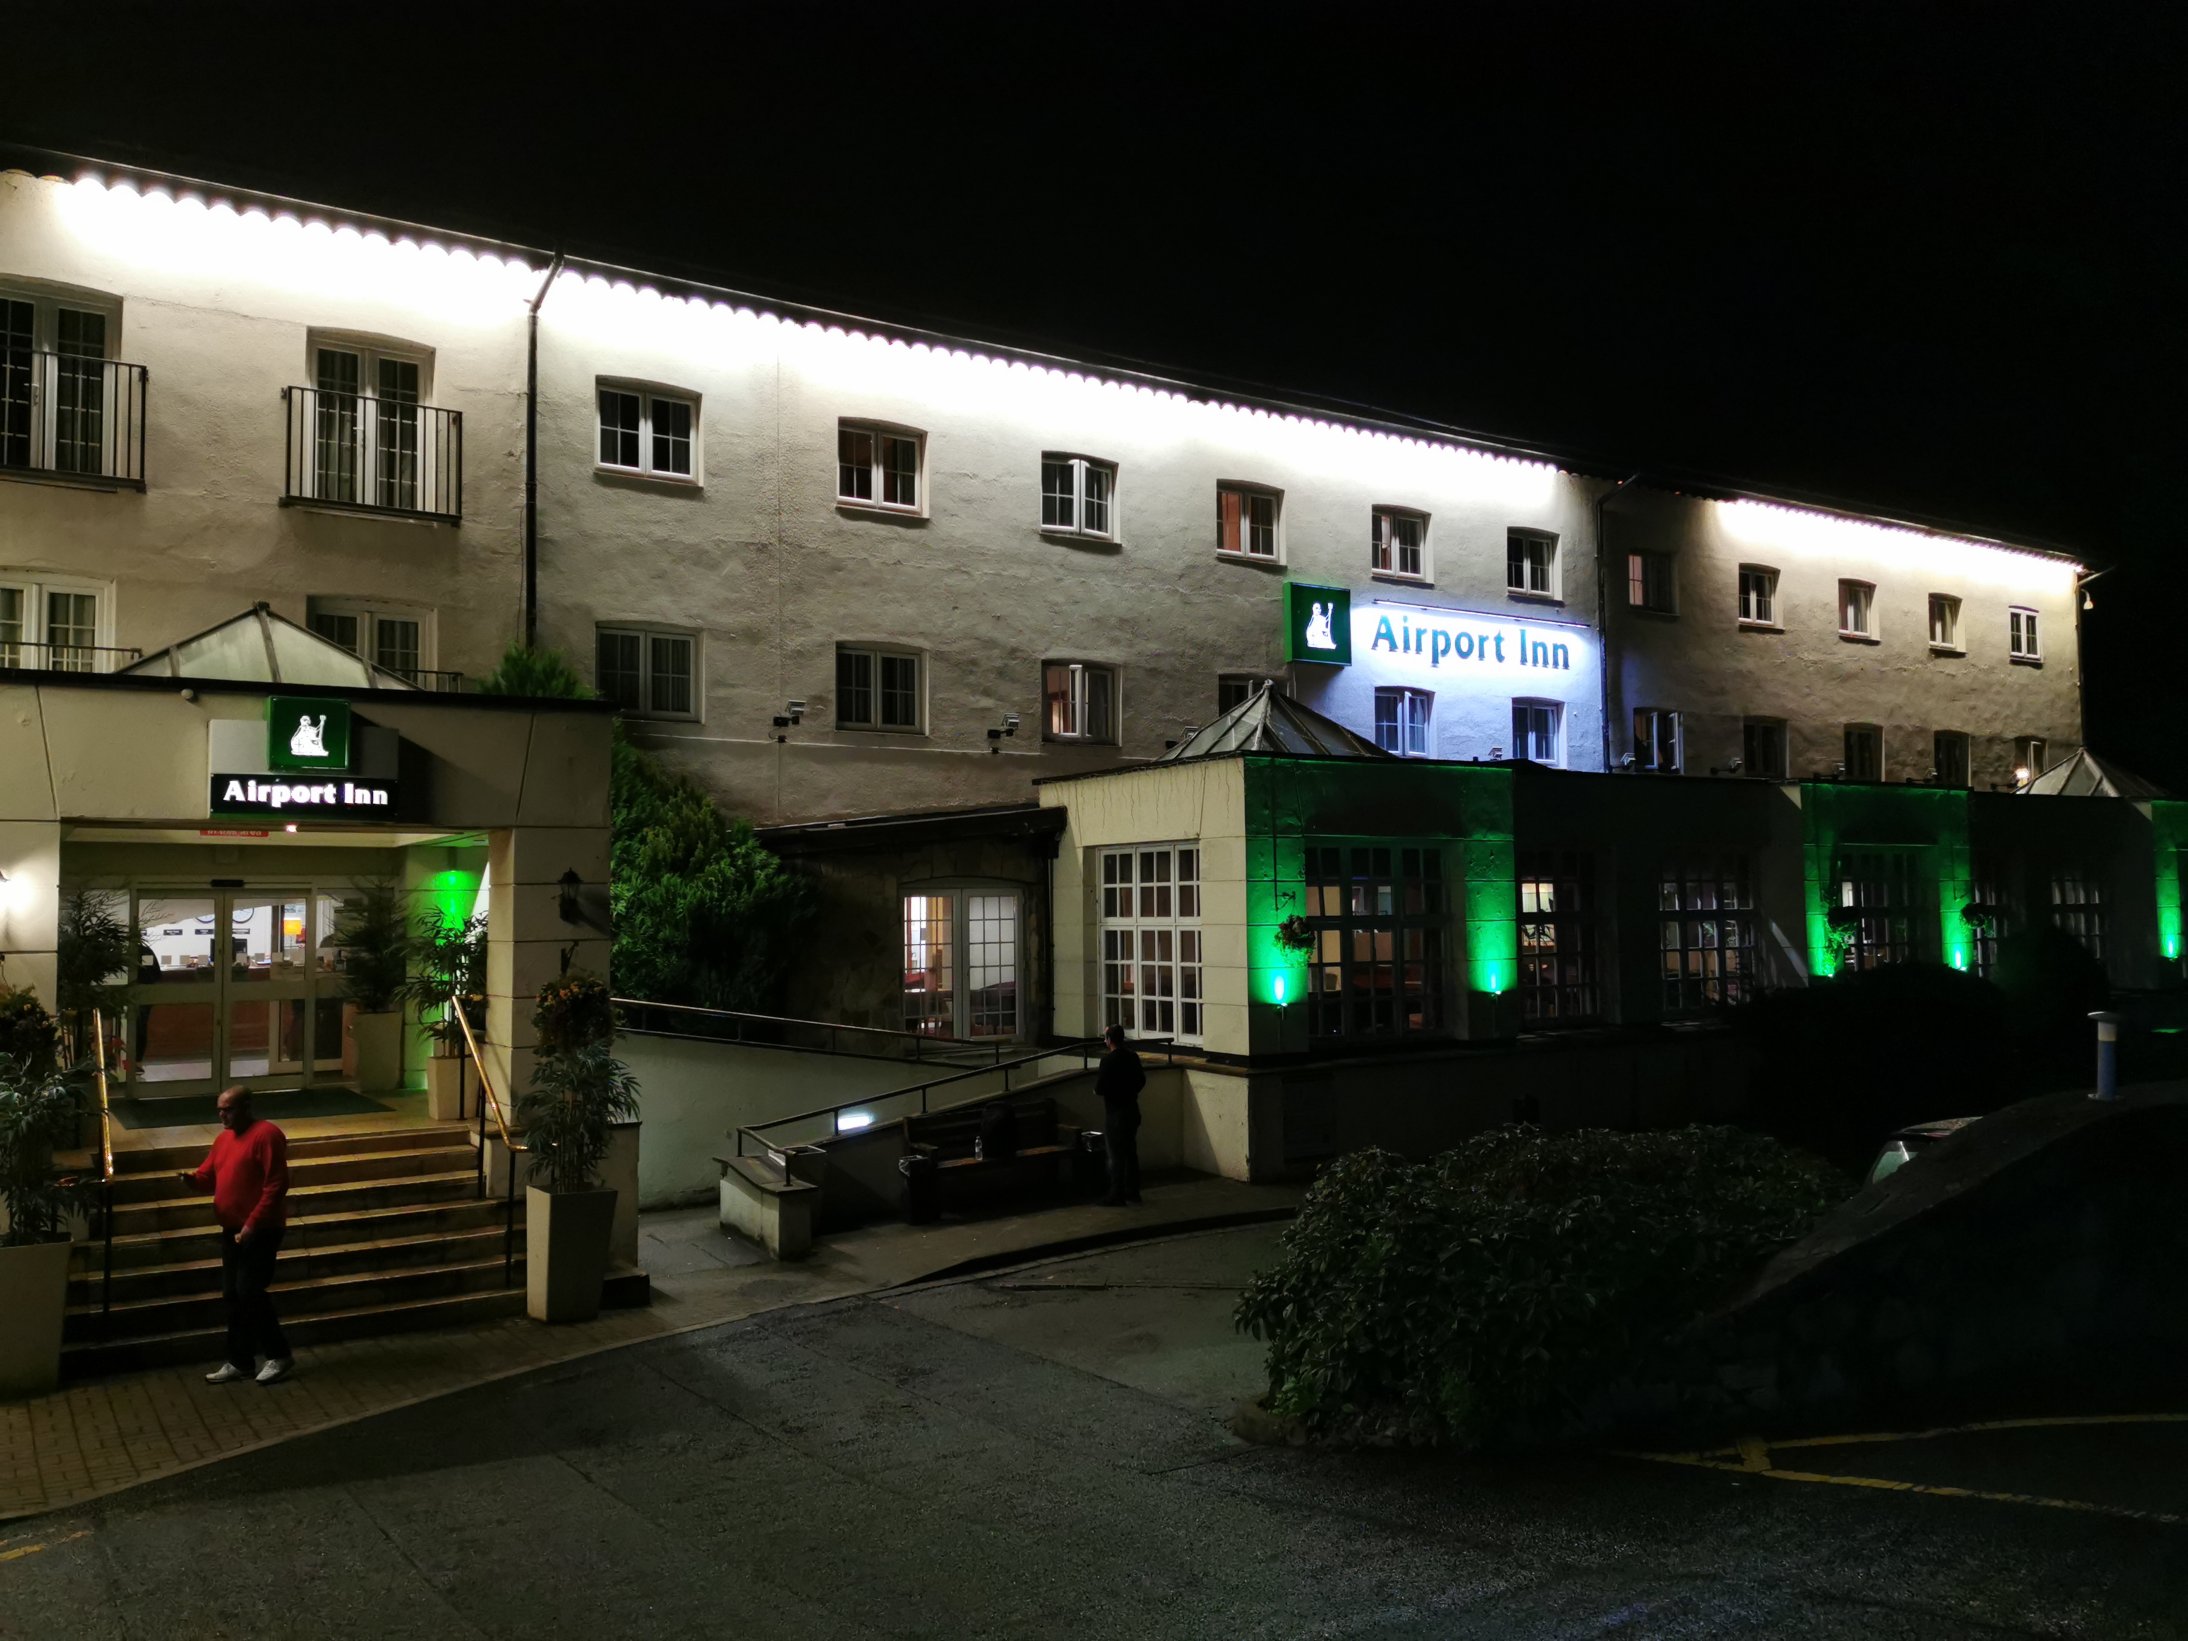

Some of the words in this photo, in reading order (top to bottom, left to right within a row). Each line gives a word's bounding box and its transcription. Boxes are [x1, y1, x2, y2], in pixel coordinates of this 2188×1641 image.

[1371, 615, 1506, 666] Airport
[1520, 629, 1570, 668] Inn
[223, 779, 337, 808] Airport
[344, 783, 388, 805] Inn
